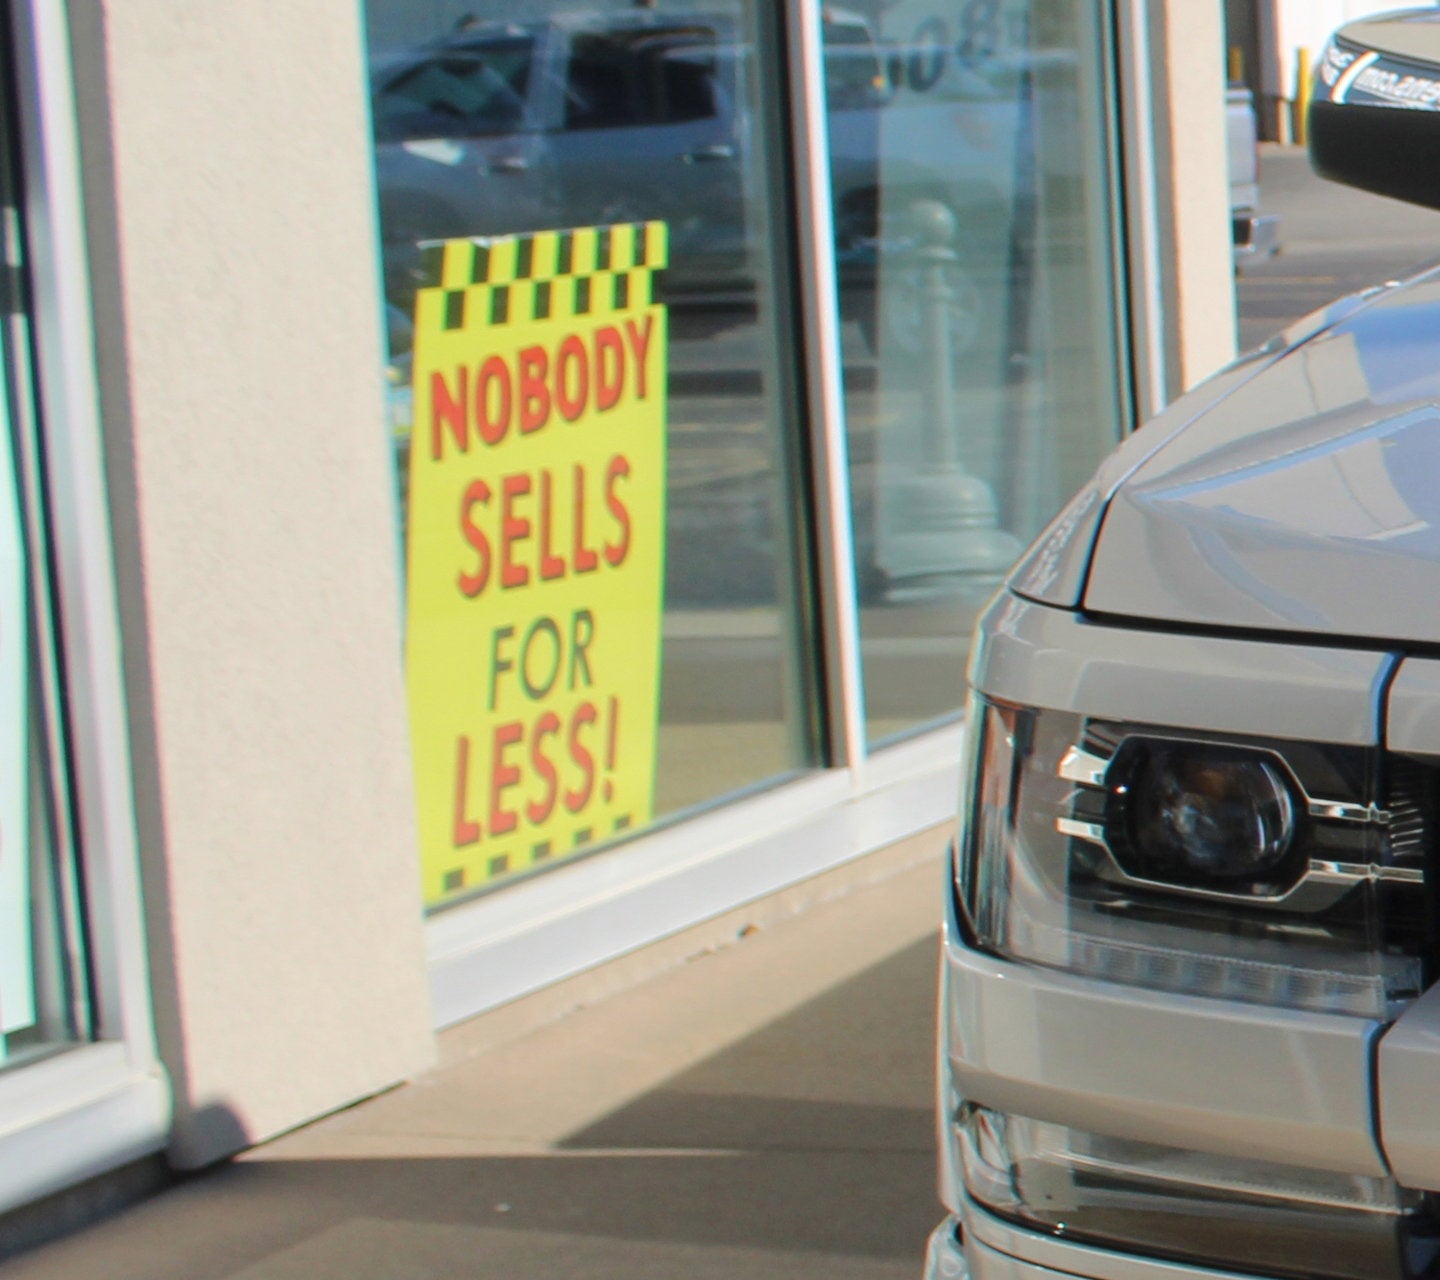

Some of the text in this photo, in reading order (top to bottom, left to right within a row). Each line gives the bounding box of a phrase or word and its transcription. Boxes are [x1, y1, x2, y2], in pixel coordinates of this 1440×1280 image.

[431, 316, 655, 461] NOBODY
[457, 455, 632, 599] SELLS
[488, 609, 594, 712] FOR
[452, 696, 619, 847] LESS!
